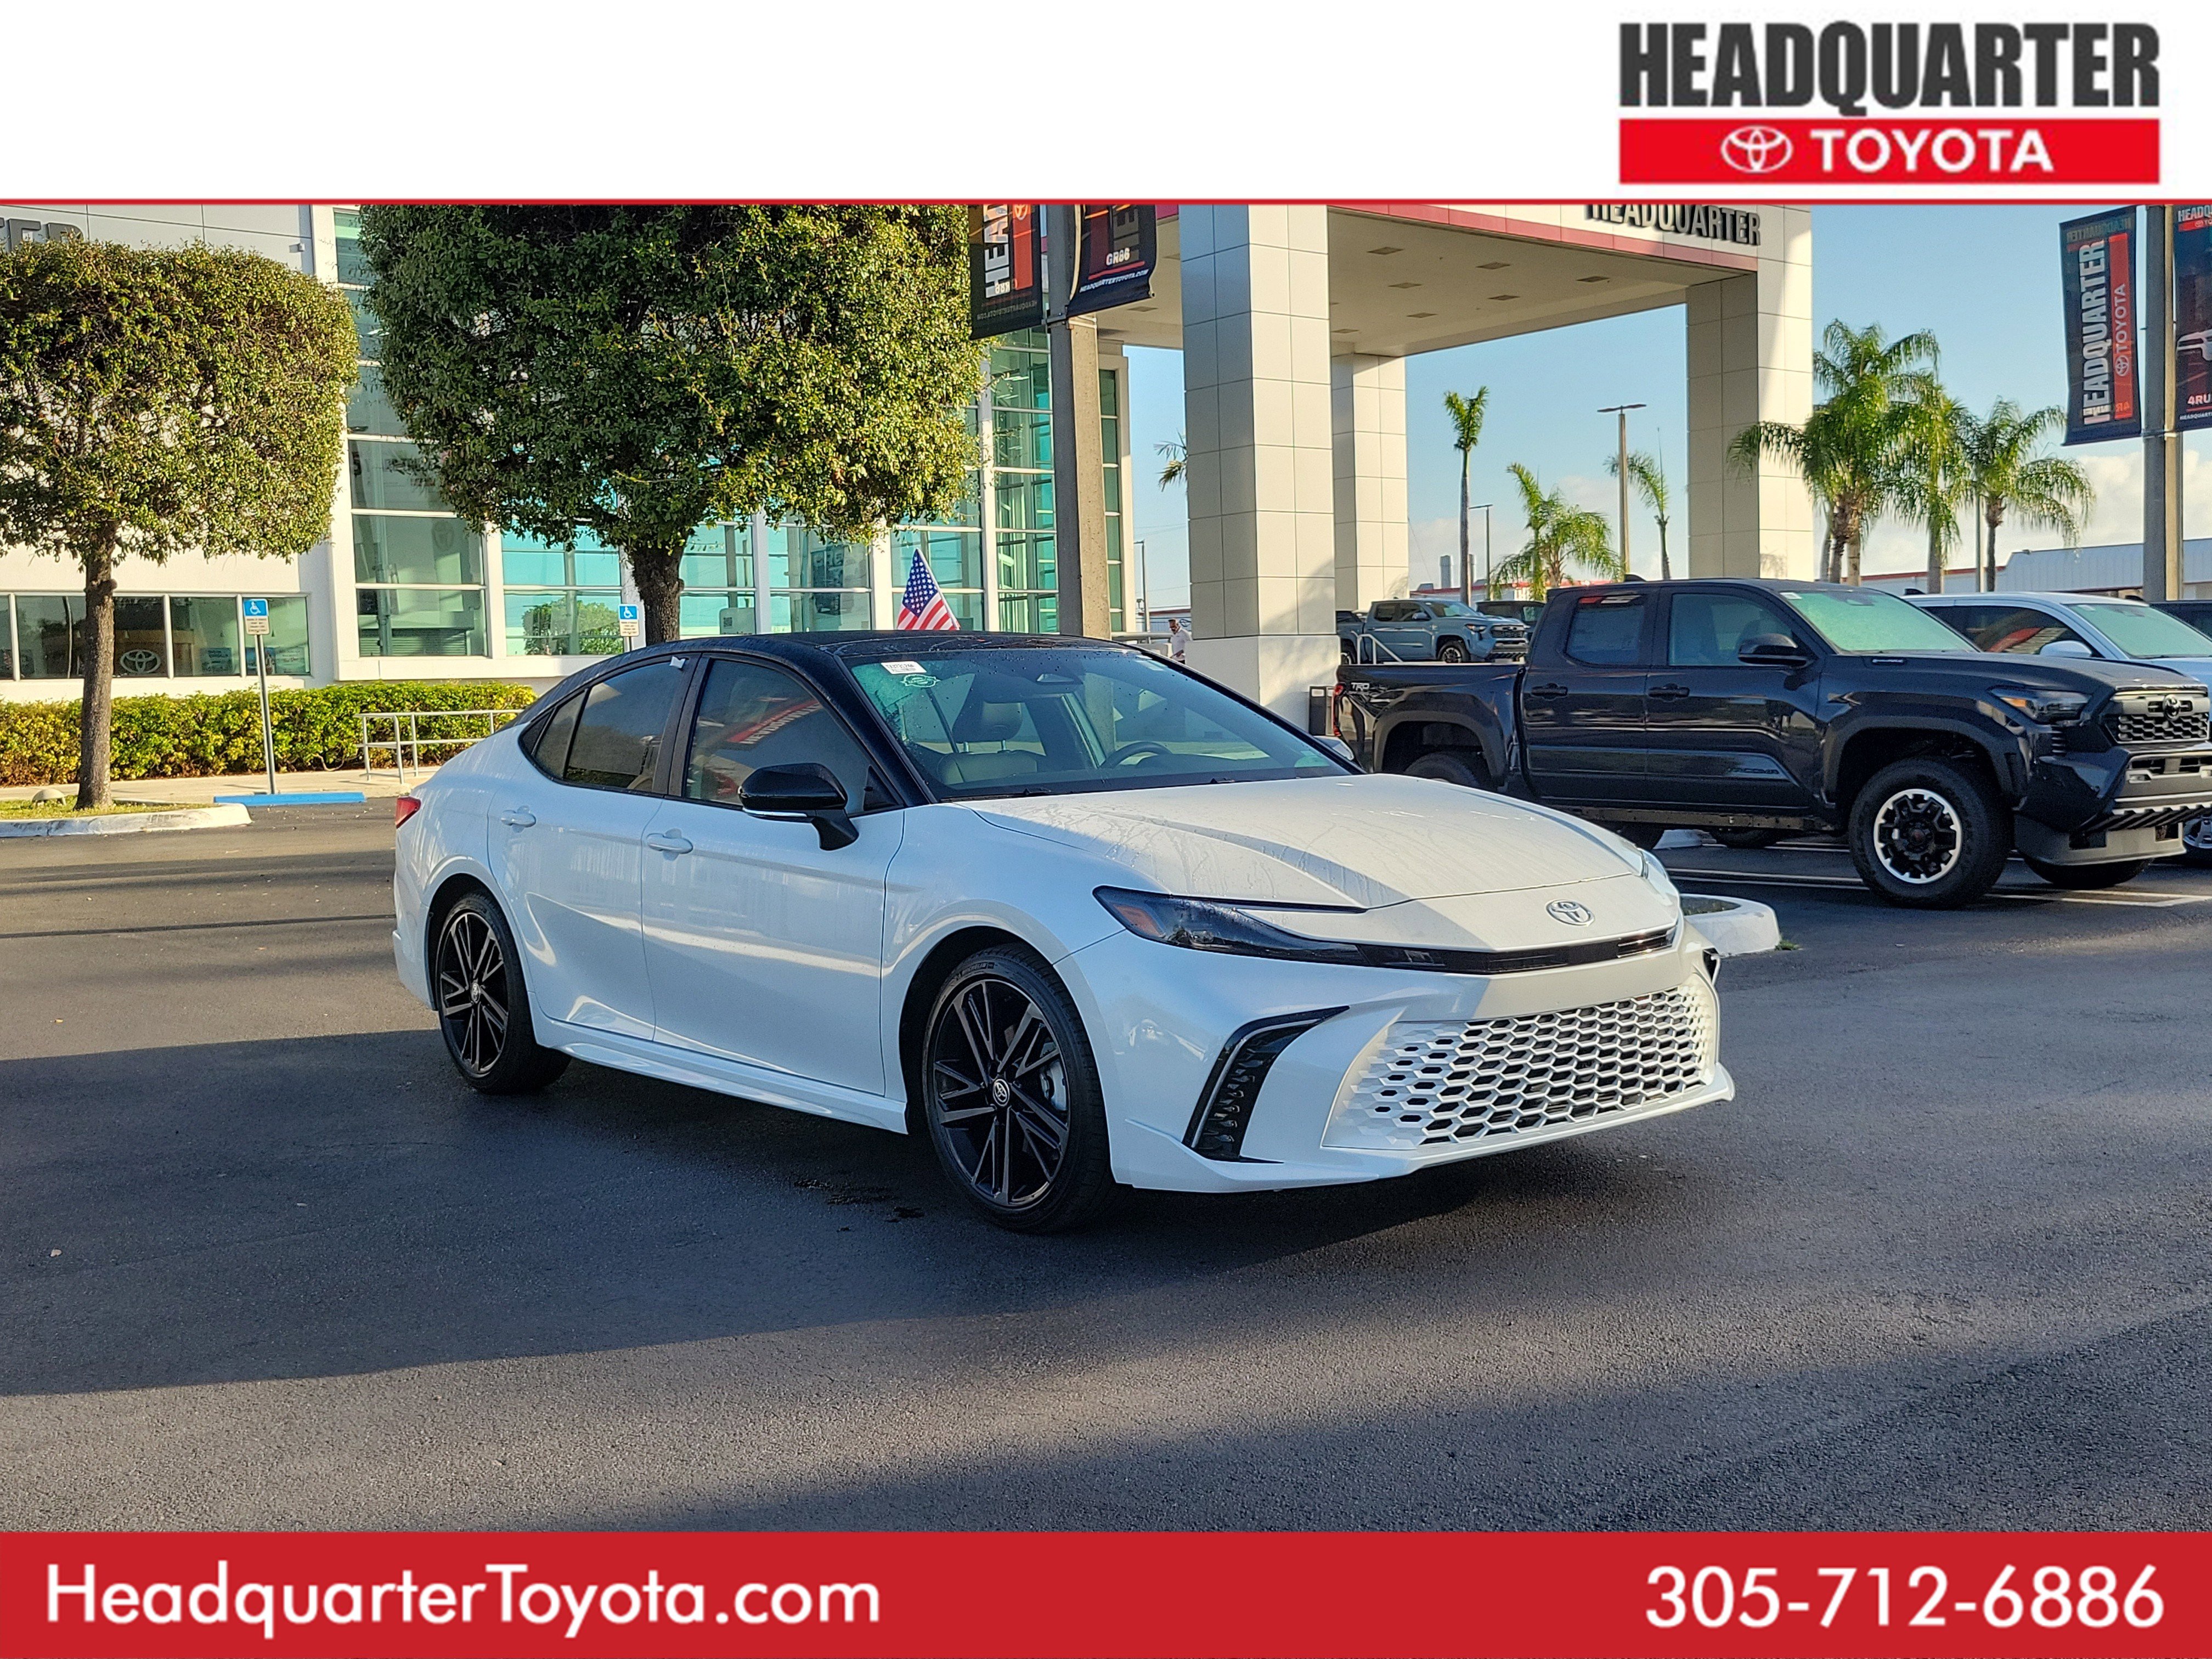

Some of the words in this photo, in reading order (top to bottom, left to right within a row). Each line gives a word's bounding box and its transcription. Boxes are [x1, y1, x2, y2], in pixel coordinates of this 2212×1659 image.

[1105, 247, 1130, 266] GR86
[2079, 239, 2112, 425] HEADQUARTER
[2114, 284, 2129, 353] TOYOTA
[1351, 682, 1370, 691] TRD
